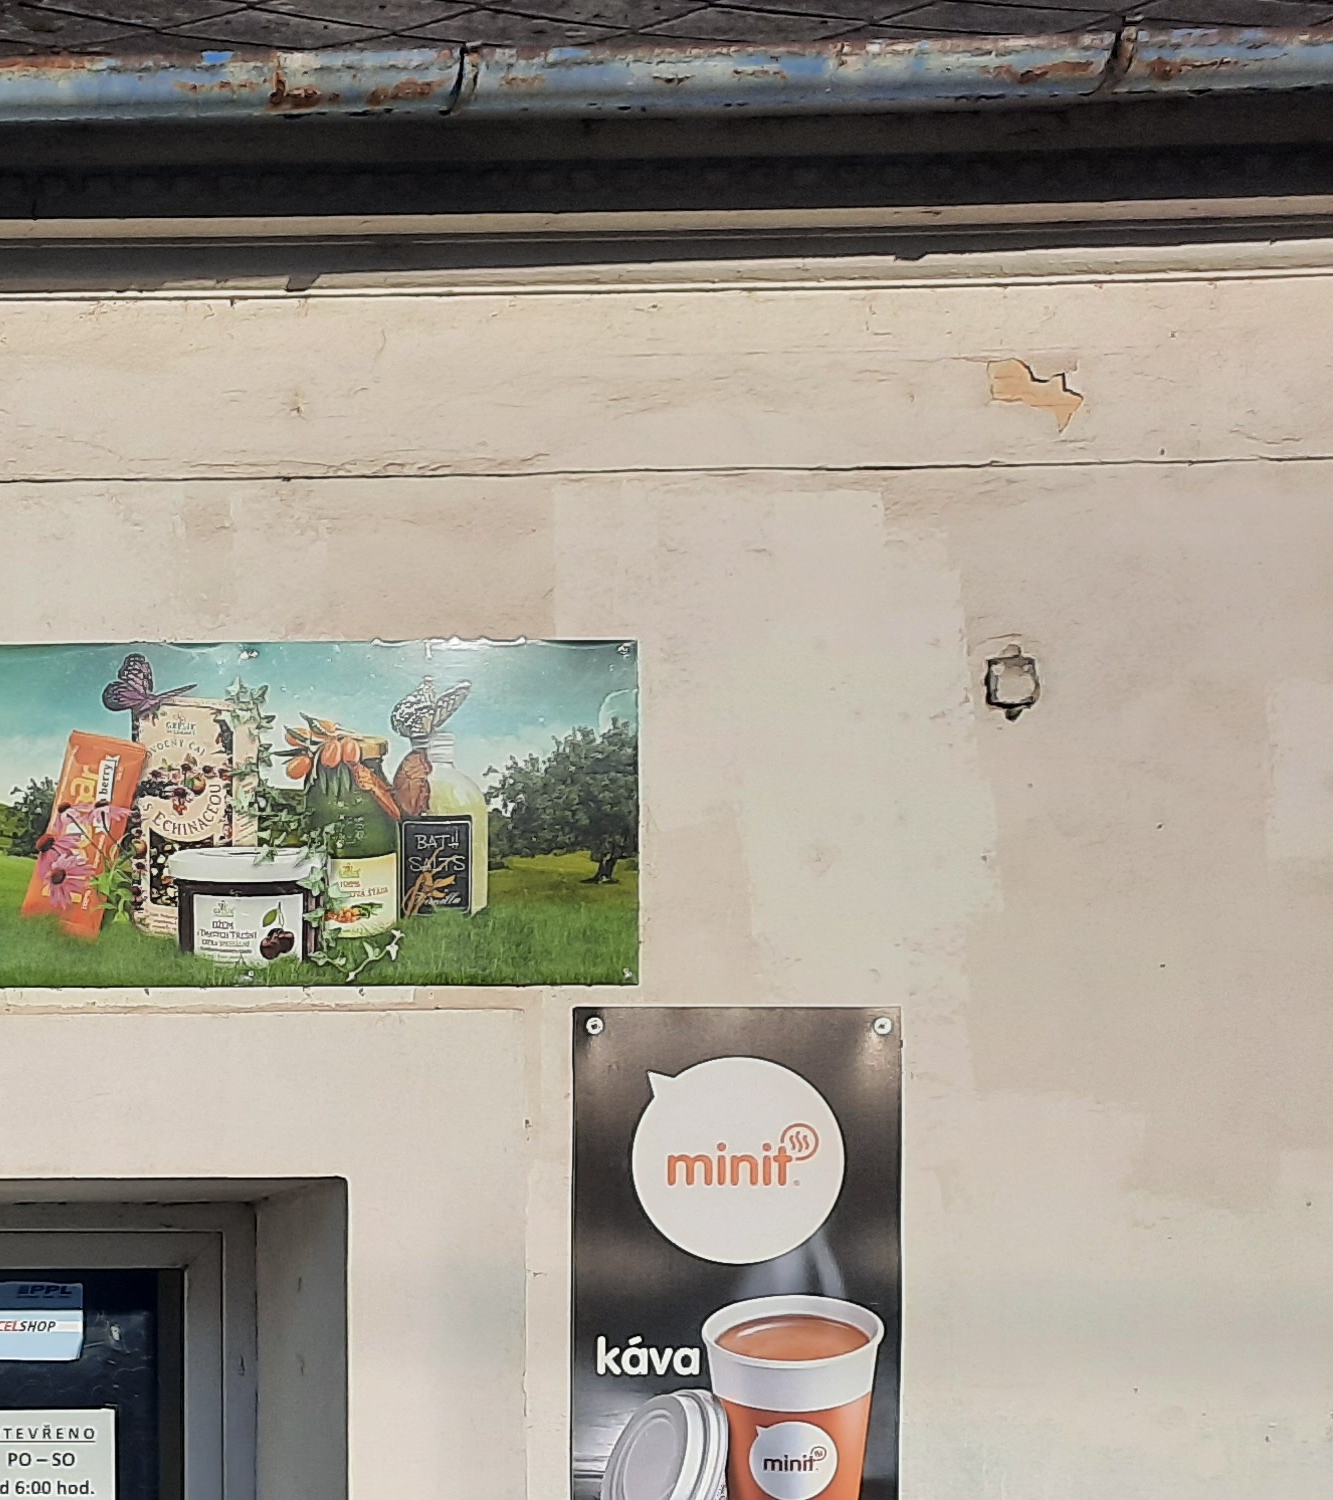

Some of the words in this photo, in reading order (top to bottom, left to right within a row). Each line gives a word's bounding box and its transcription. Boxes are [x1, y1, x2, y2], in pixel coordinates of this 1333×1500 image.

[414, 829, 459, 850] BATH
[667, 1143, 793, 1187] minit
[597, 1336, 701, 1377] káva
[8, 1453, 31, 1466] PO
[52, 1453, 75, 1466] SO
[763, 1455, 817, 1473] minit
[15, 1481, 51, 1494] 6:00
[58, 1480, 95, 1494] hod.
